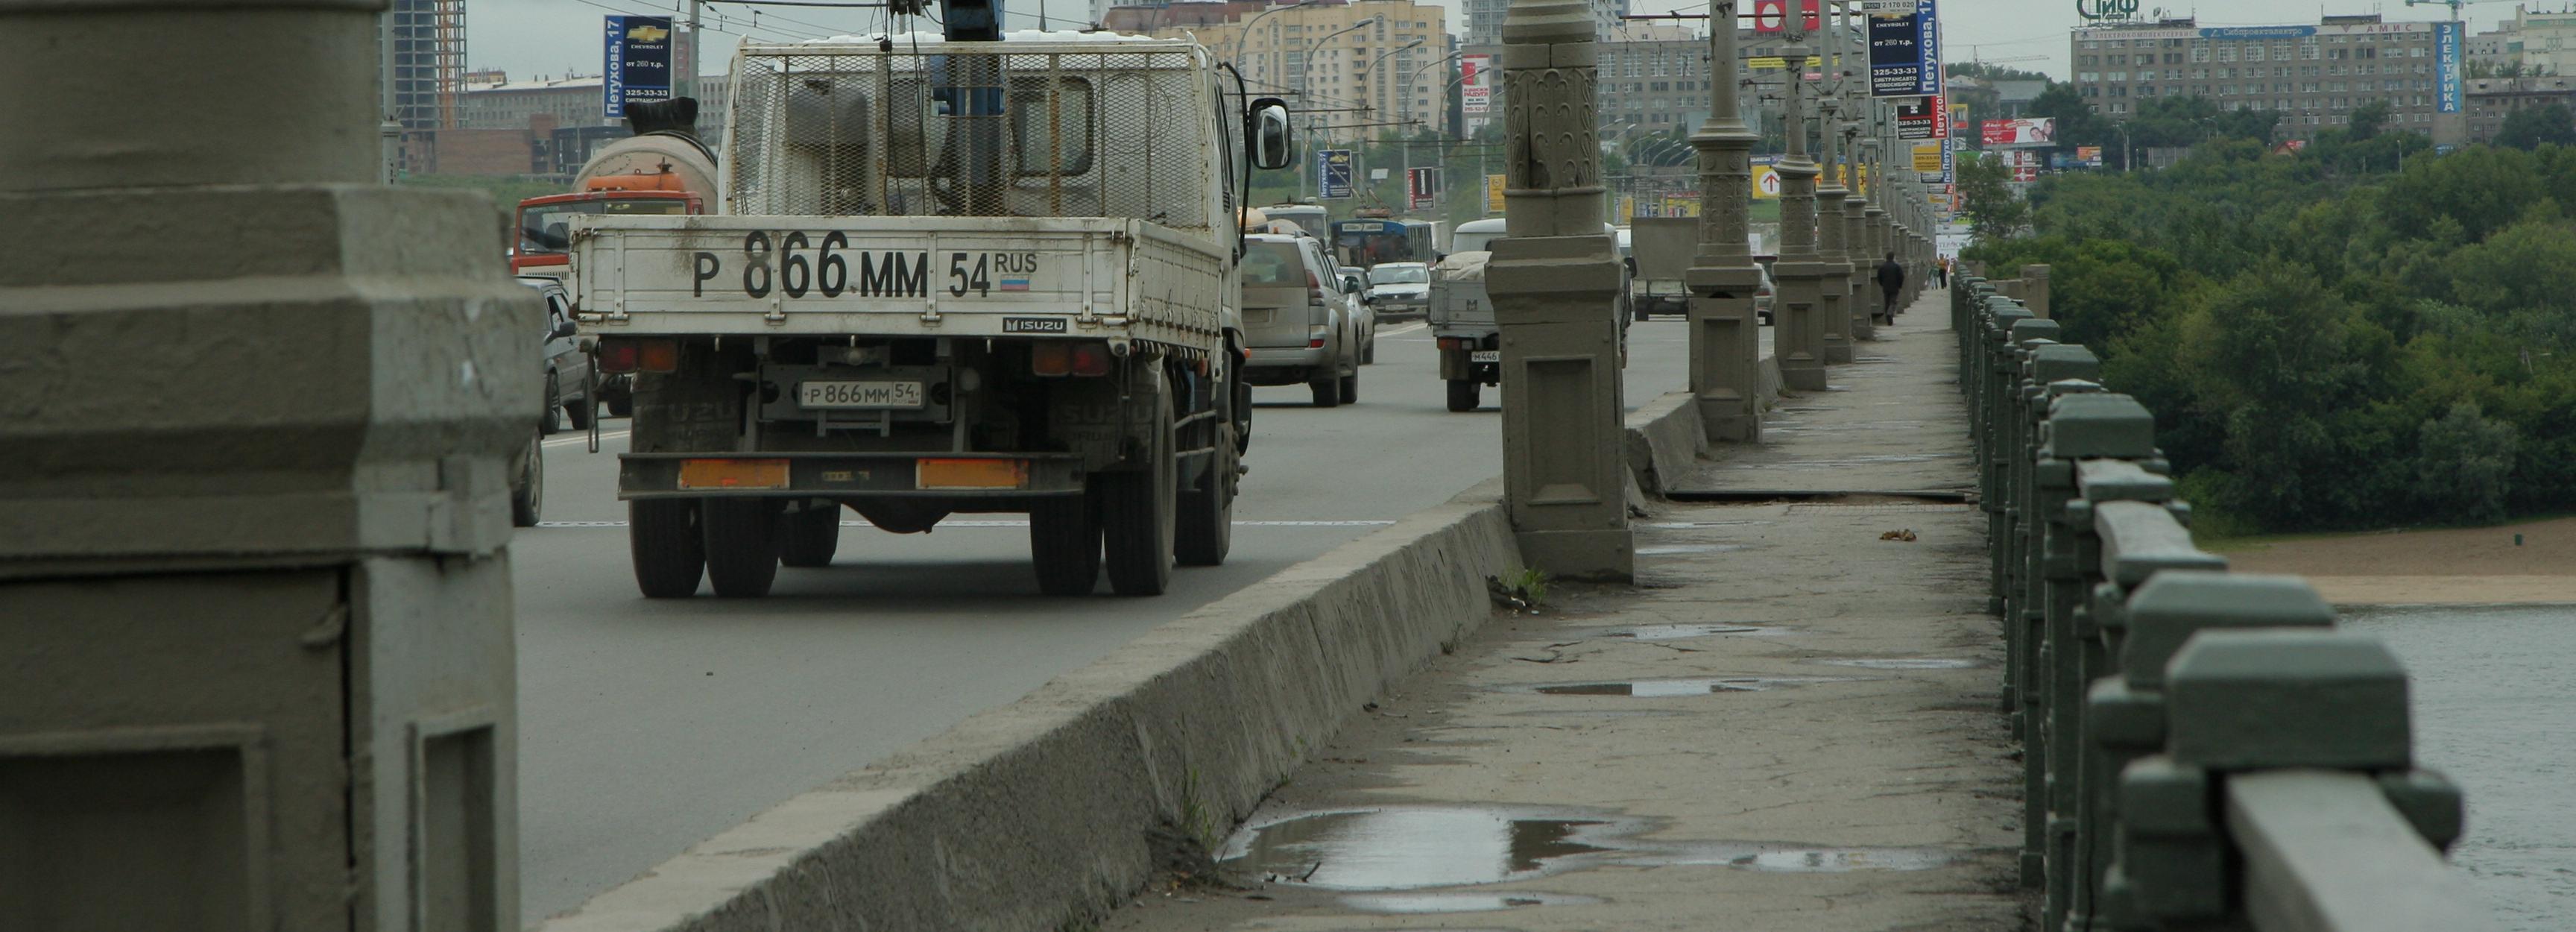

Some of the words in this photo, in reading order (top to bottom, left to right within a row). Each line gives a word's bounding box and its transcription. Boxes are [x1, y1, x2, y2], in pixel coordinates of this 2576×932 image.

[607, 20, 619, 37] 17
[2367, 25, 2412, 33] АМИС
[1923, 17, 1936, 92] Петухова,
[2442, 25, 2455, 111] ЭЛЕКТРИКА
[607, 40, 622, 114] Петухова,
[1936, 97, 1946, 136] Петухо
[950, 253, 991, 298] 54
[995, 253, 1038, 274] RUS
[1020, 321, 1064, 331] ISUZU
[895, 384, 915, 398] 54
